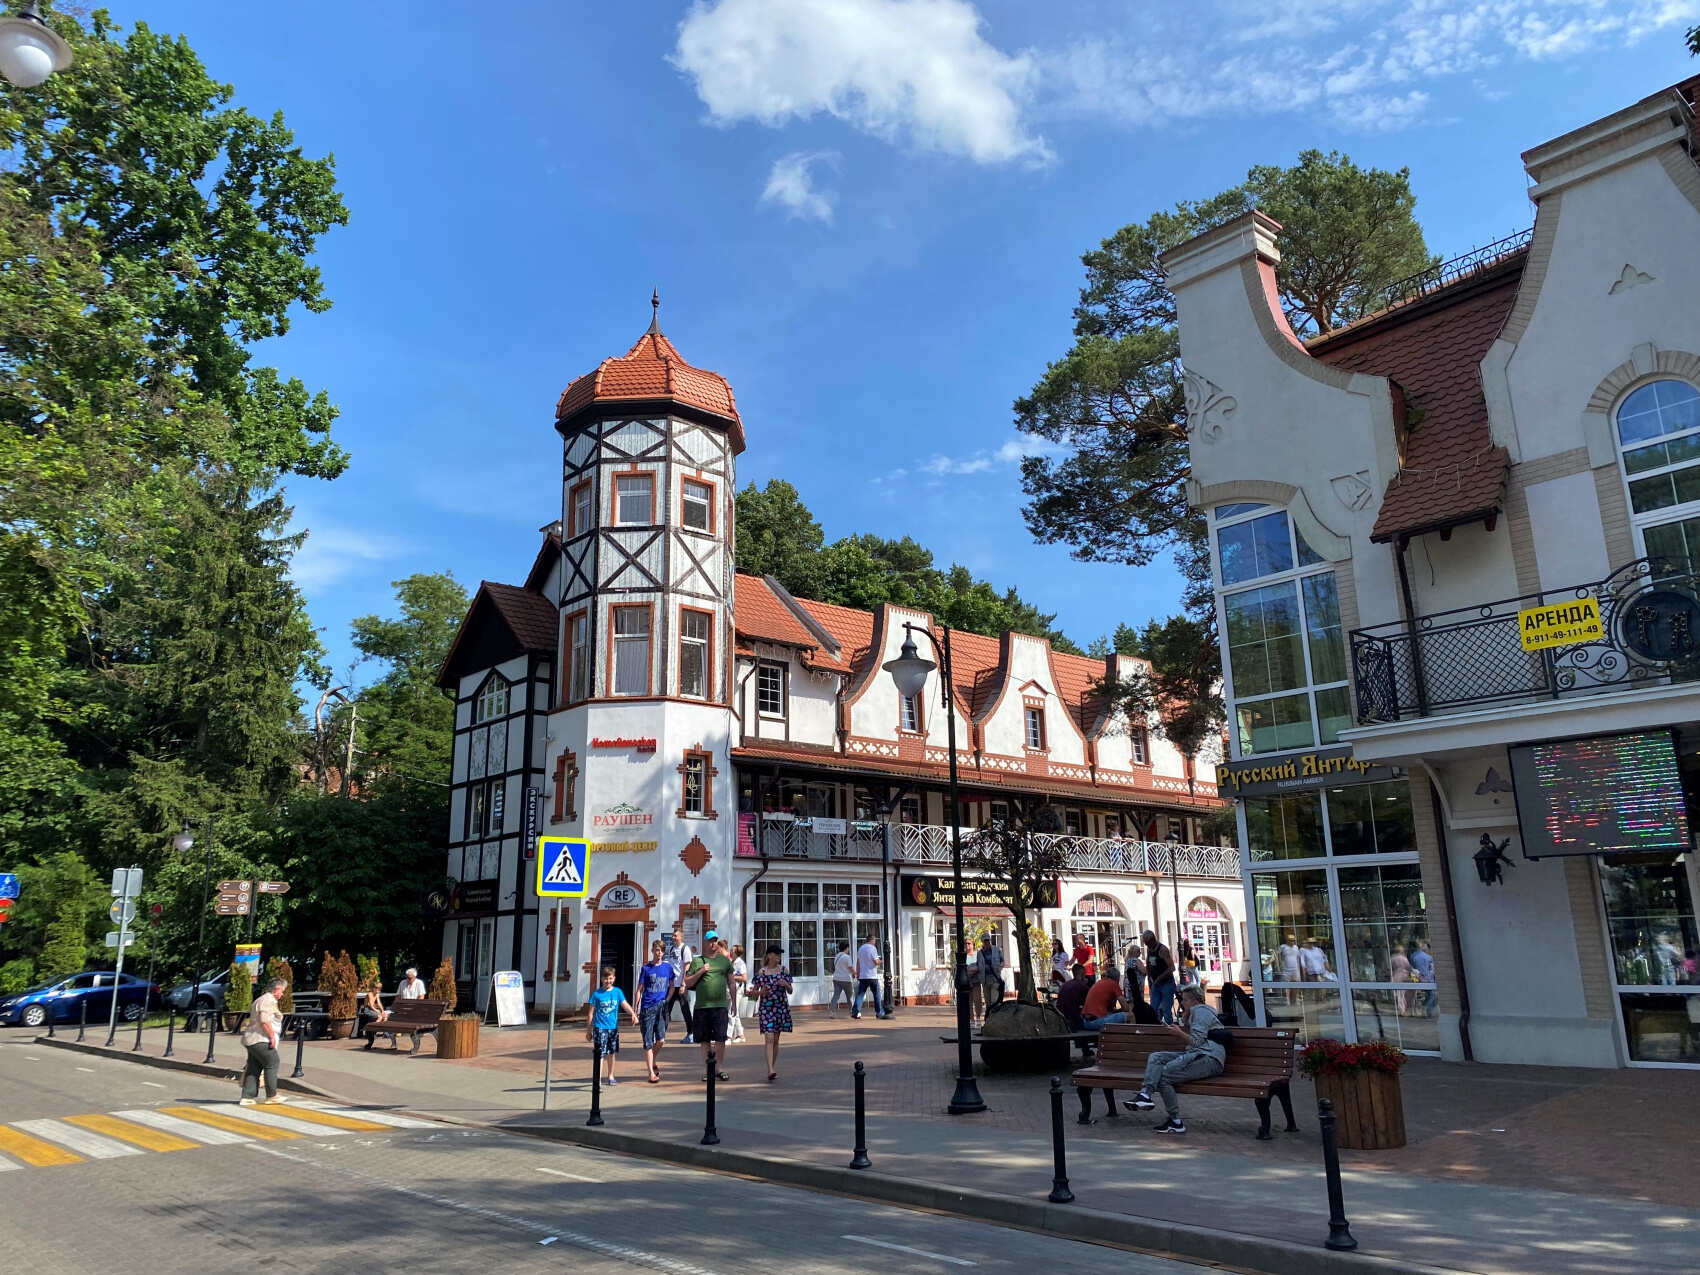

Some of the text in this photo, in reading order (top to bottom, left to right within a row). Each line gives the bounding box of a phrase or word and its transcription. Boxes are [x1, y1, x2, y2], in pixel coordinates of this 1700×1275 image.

[1525, 604, 1595, 631] АРЕНДА
[1526, 625, 1599, 645] 8-911-49-111-49
[1216, 754, 1383, 792] Русский Янтар
[527, 789, 536, 849] ЭКСКУРСИИ
[593, 814, 653, 826] РАУШЕН
[615, 889, 629, 901] RE
